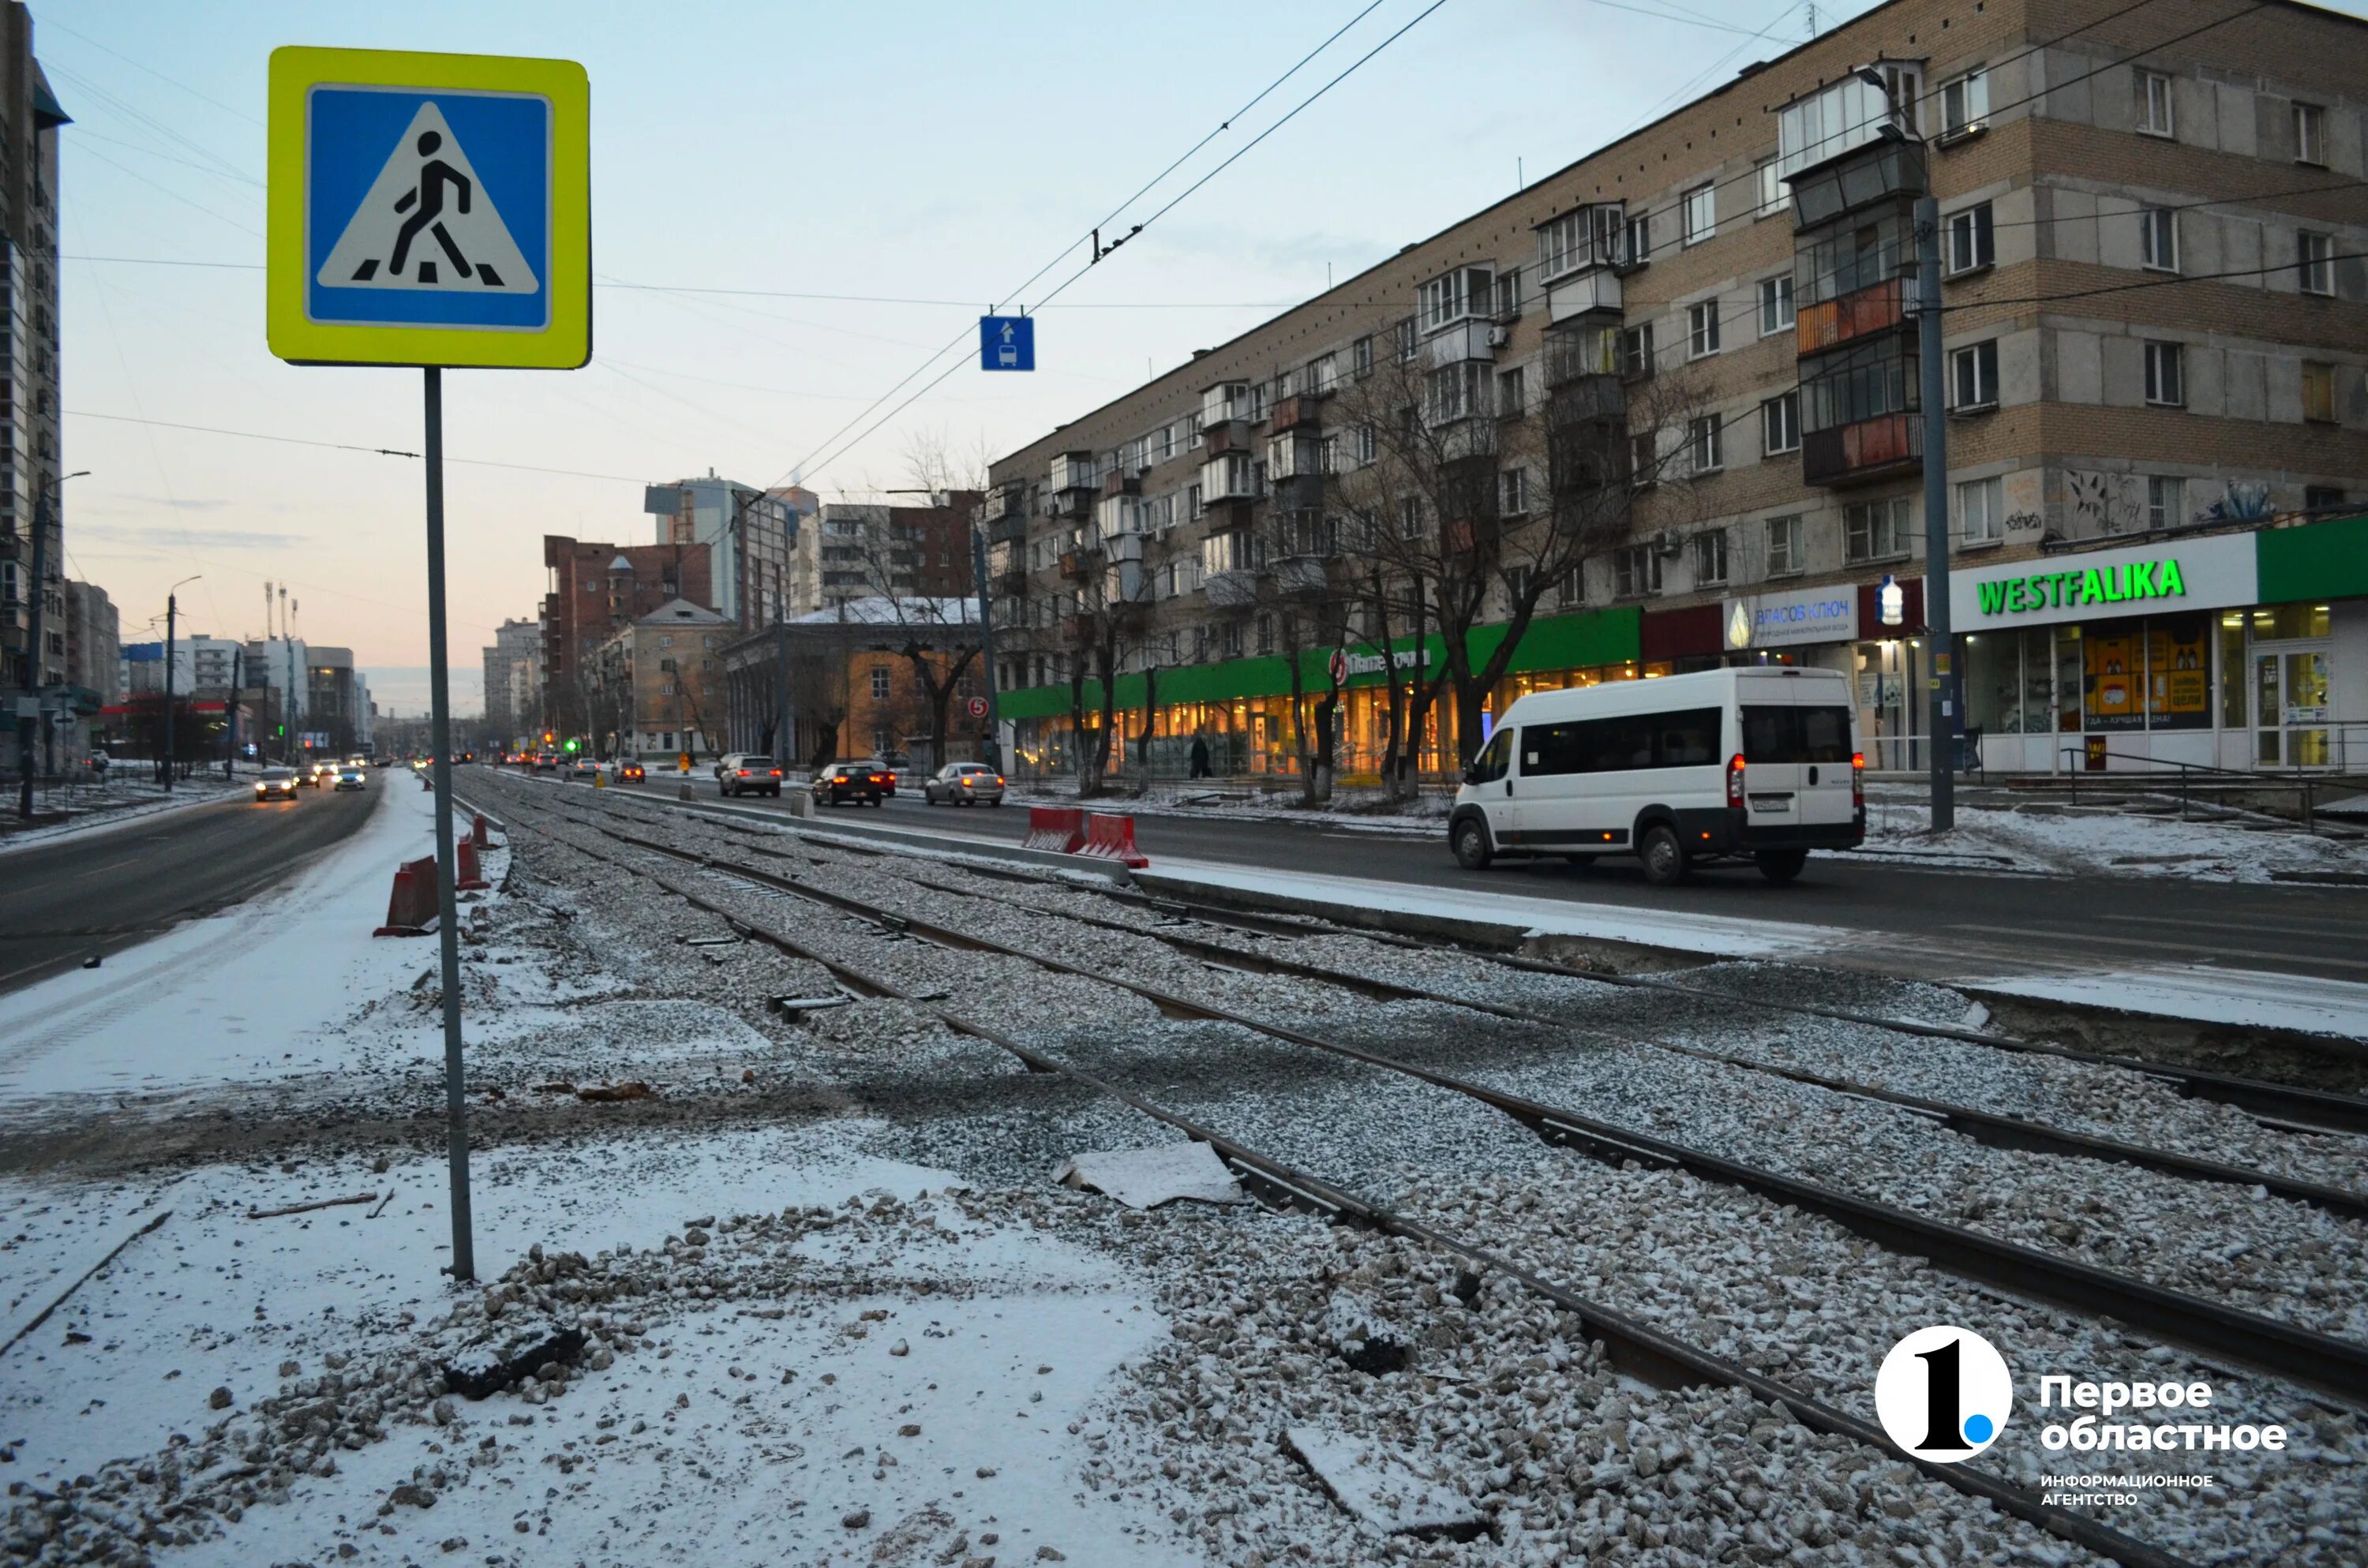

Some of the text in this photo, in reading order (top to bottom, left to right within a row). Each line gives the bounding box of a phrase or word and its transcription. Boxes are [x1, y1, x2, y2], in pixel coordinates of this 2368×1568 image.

[1976, 559, 2186, 616] WESTFALIKA
[1808, 600, 1849, 619] КЛЮЧ
[2149, 714, 2171, 724] ЕНА!
